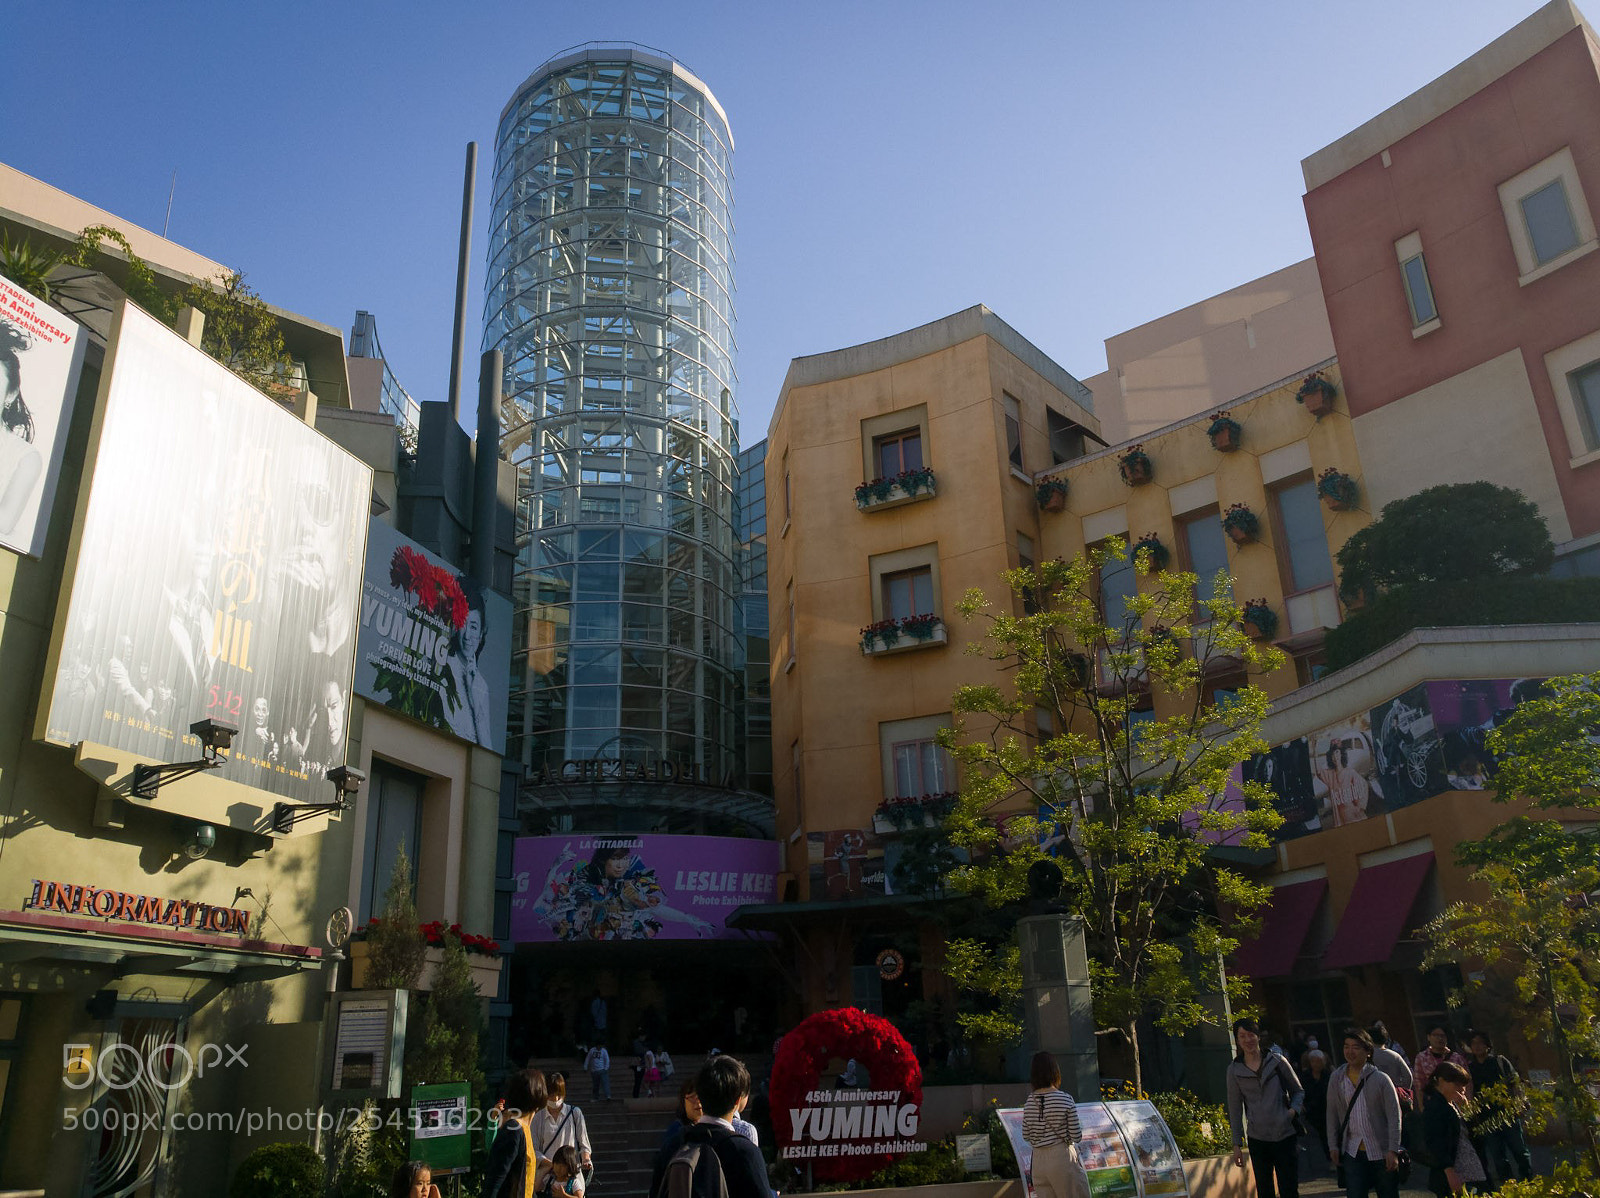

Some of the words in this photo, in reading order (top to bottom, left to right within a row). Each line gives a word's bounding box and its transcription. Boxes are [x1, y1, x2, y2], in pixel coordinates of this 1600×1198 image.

[0, 293, 8, 305] h
[9, 300, 71, 344] Anniversary
[15, 317, 53, 343] Exhibition
[363, 594, 449, 666] YUMING
[366, 651, 406, 677] photographed
[406, 667, 414, 681] by
[414, 672, 430, 687] LESLIE
[378, 641, 413, 665] FOREVER
[413, 657, 432, 675] LOVE
[206, 684, 243, 716] 5.12
[579, 840, 591, 849] LA
[592, 839, 643, 849] CITTADELLA
[513, 871, 530, 892] G
[675, 870, 736, 892] LESLIE
[740, 872, 774, 893] KEE
[32, 880, 251, 934] INFORMATION
[692, 895, 720, 906] Photo
[722, 895, 765, 906] Exhibition
[805, 1090, 832, 1103] 45th
[834, 1088, 901, 1103] Anniversary
[789, 1103, 918, 1142] YUMING
[782, 1145, 817, 1159] LESLIE
[819, 1144, 839, 1157] KEE
[840, 1143, 872, 1156] Photo
[873, 1140, 928, 1155] Exhibition
